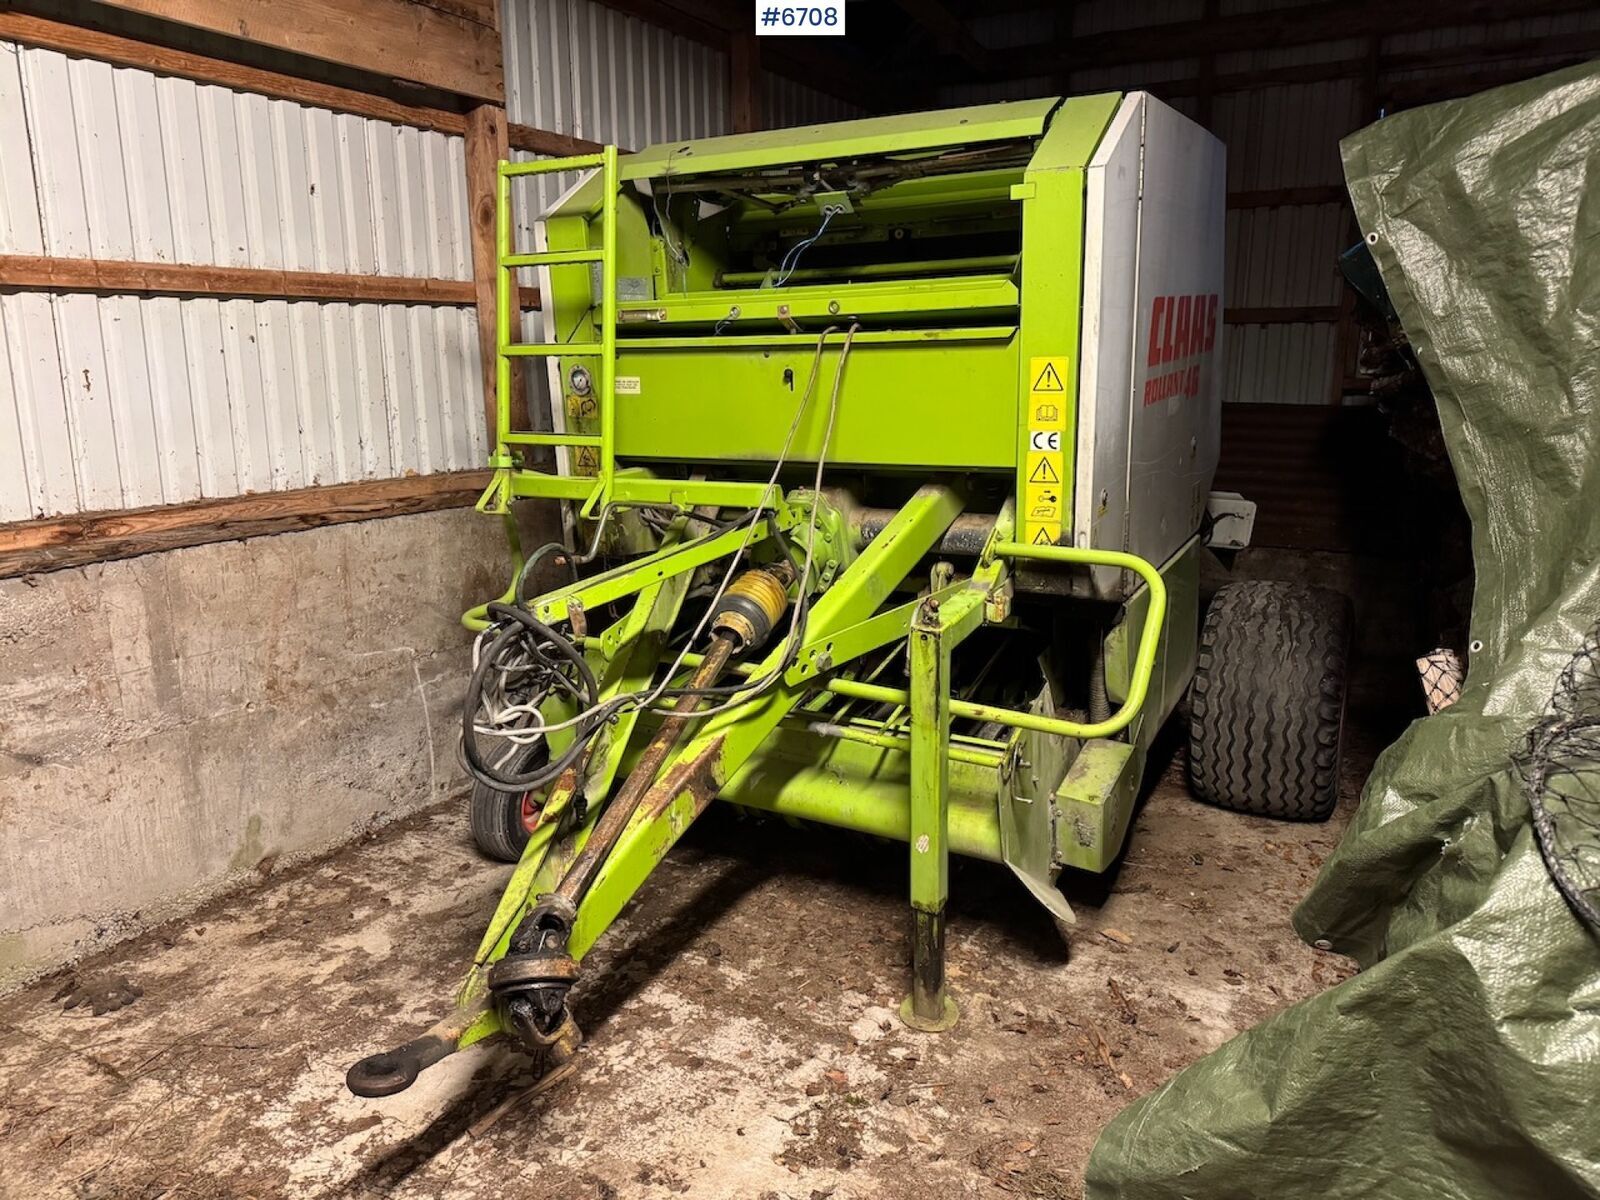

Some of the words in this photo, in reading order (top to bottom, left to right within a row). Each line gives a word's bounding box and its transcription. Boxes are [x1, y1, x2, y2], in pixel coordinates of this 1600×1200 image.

[1148, 294, 1218, 367] CLAAS
[1144, 369, 1185, 408] ROLLANT
[1033, 432, 1058, 449] CE
